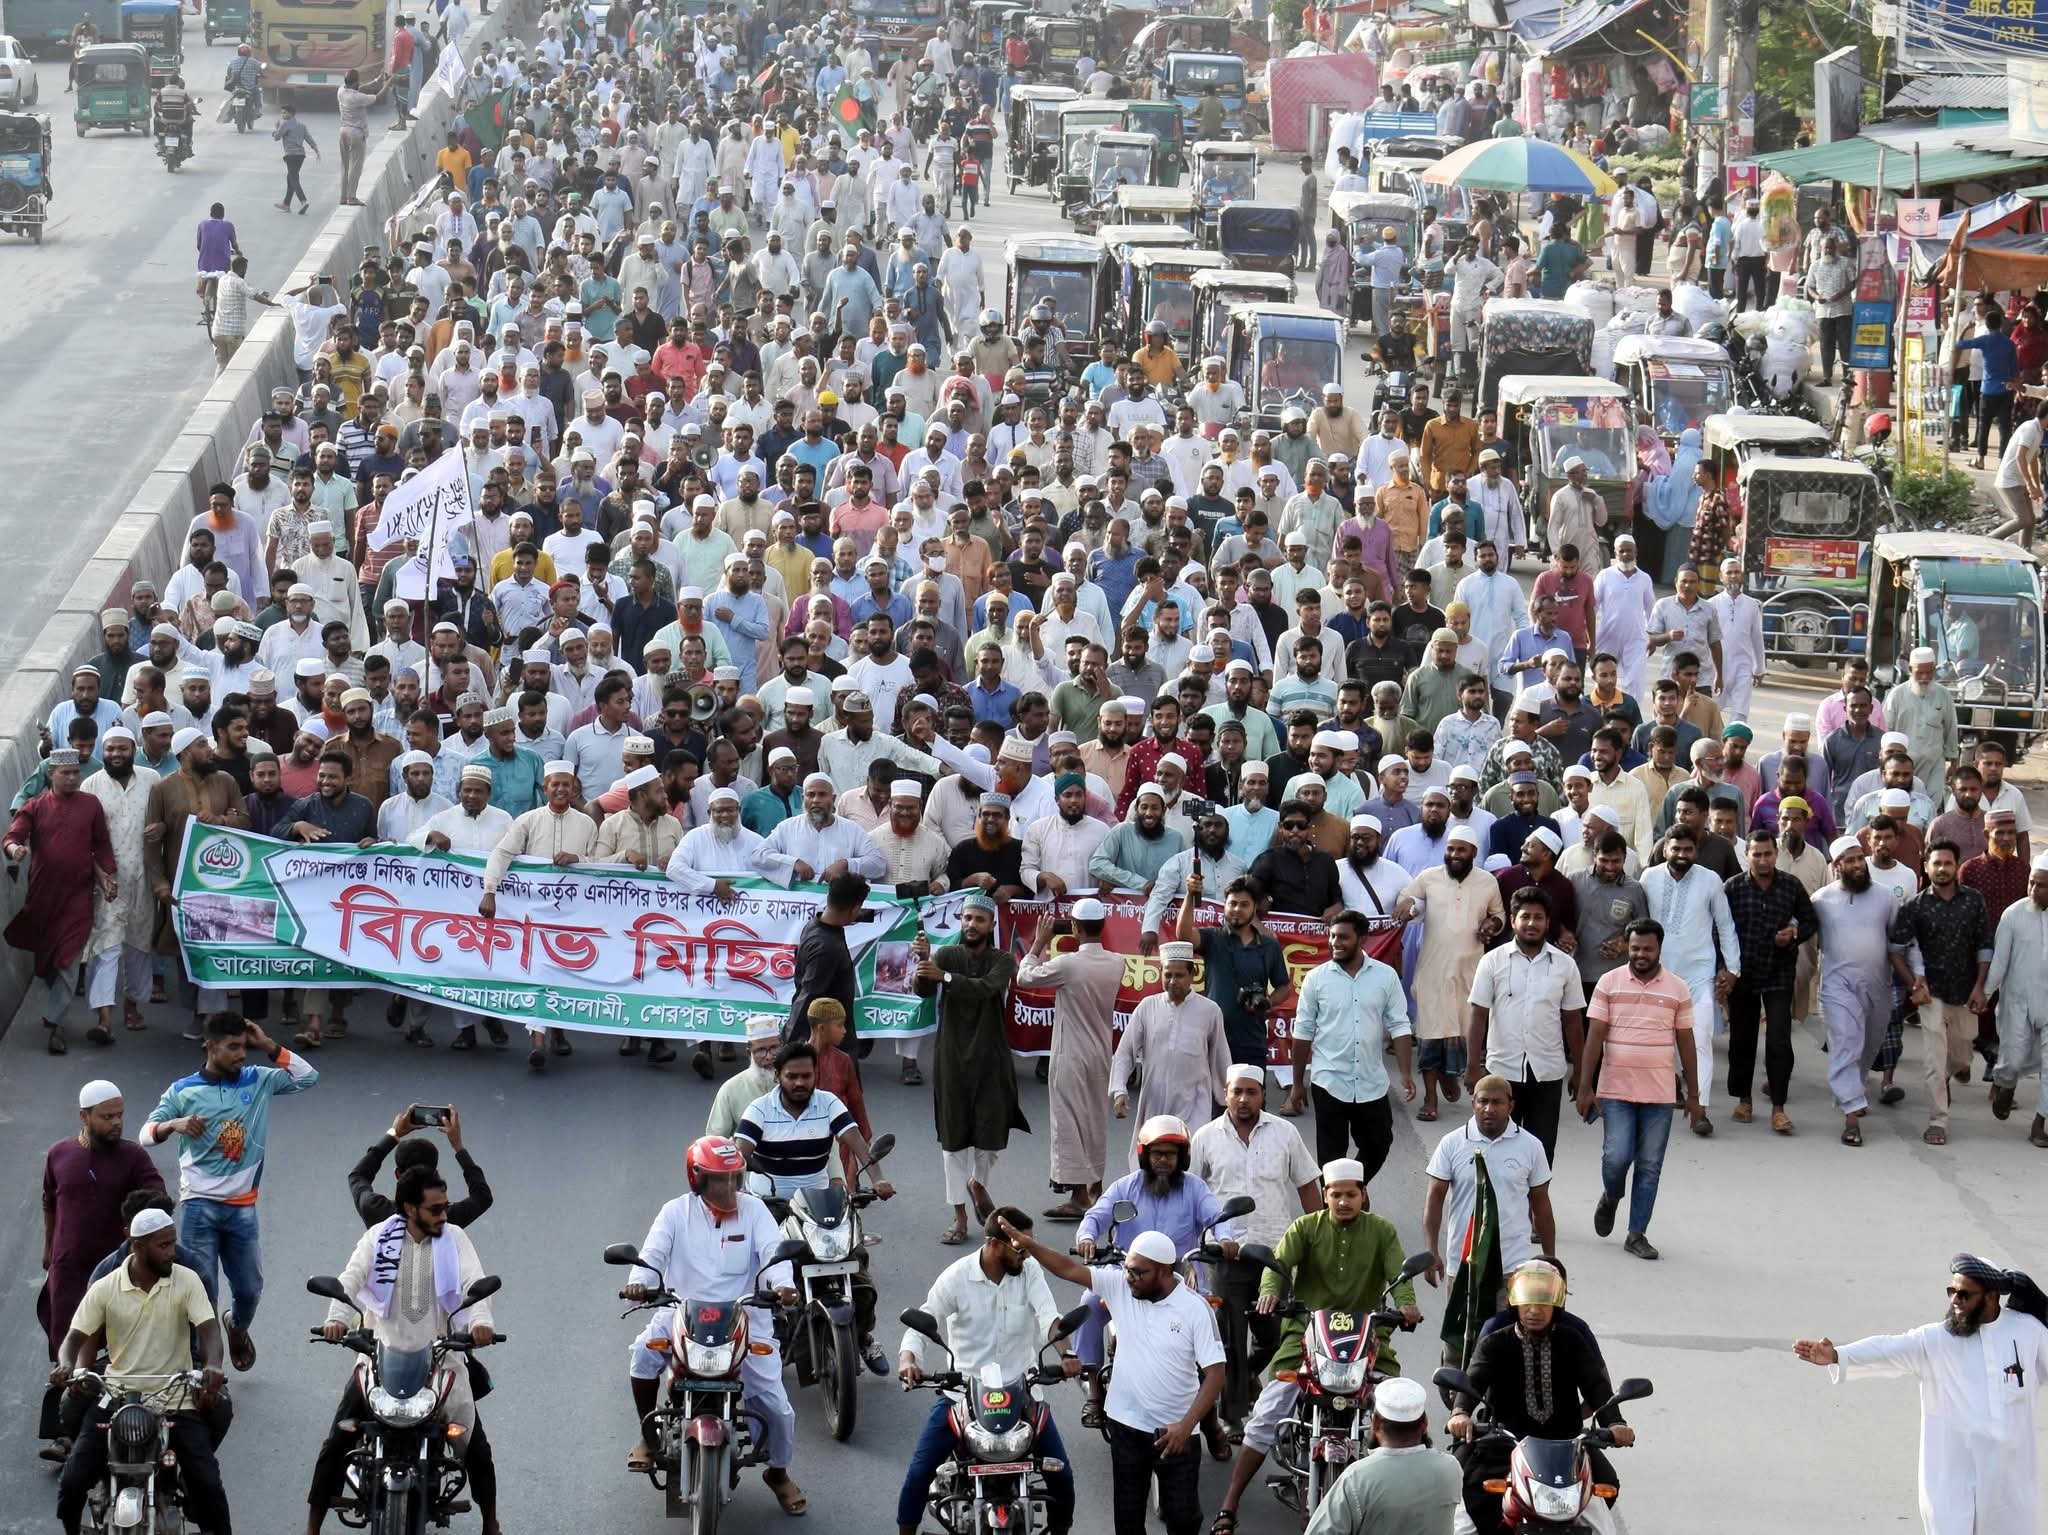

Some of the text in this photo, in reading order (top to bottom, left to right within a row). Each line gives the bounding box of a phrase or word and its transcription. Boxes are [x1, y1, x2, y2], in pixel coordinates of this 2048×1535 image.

[1995, 26, 2035, 42] ATM
[285, 857, 368, 881] গোপালগঞ্জে
[374, 856, 418, 886] নিষিদ্ধ
[423, 863, 473, 889] ঘোষিত
[537, 875, 579, 911] কর্তৃক
[584, 879, 652, 908] এনসিপির
[656, 883, 690, 911] উপর
[766, 897, 818, 922] হামলার
[330, 884, 609, 973] বিক্ষোভ
[208, 955, 317, 977] আয়োজনে
[440, 984, 540, 1010] জামায়াতে
[545, 986, 631, 1026] ইসলামী,
[640, 1002, 709, 1031] শেরপুর
[983, 1408, 1011, 1416] ALLAHU
